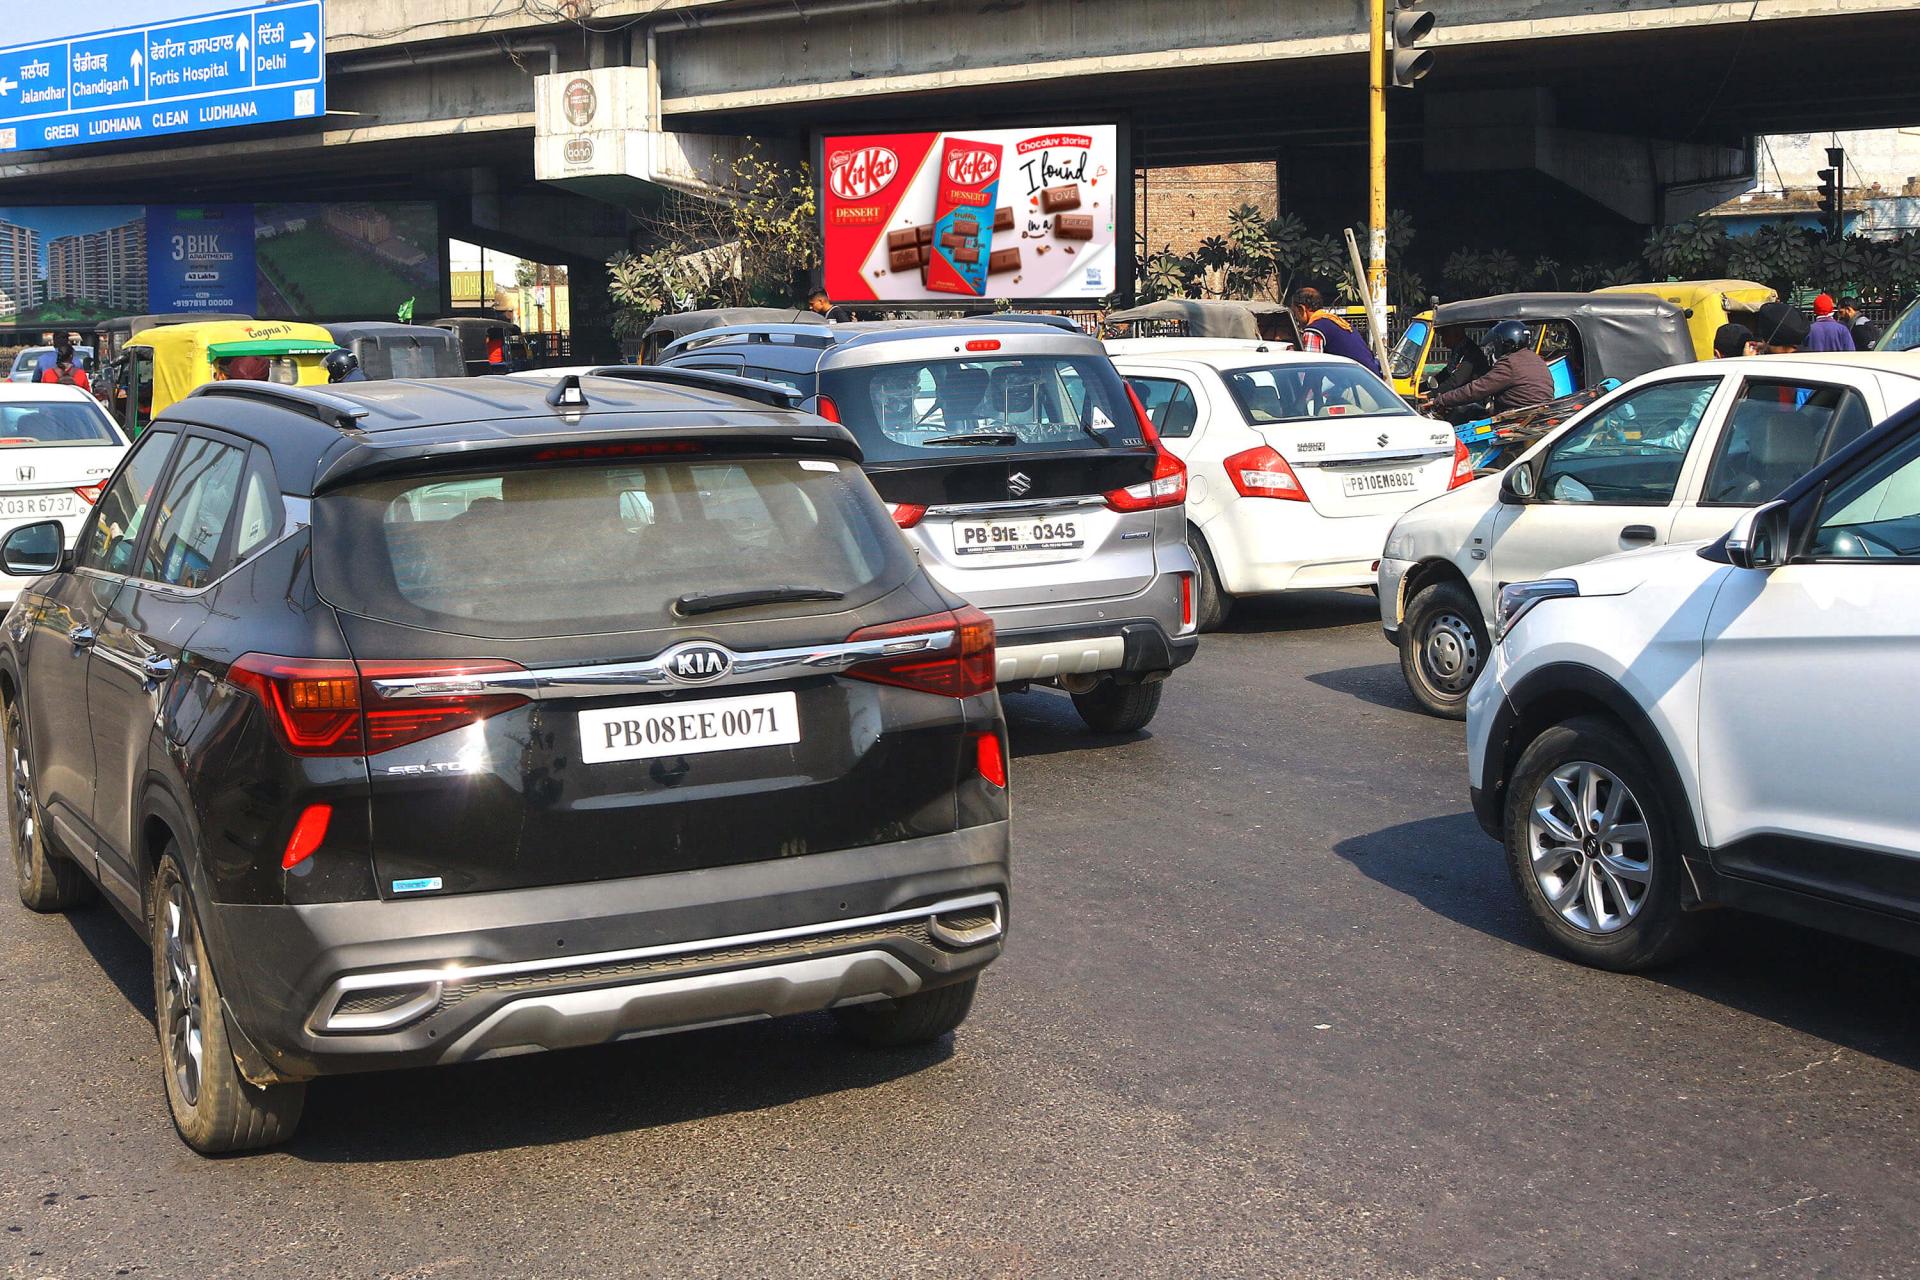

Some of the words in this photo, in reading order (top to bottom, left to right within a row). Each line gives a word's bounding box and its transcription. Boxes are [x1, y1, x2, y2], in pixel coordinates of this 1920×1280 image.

[257, 22, 285, 46] ਦਿੱਲੀ
[188, 34, 235, 56] ਹਸਪਤਾਲ
[20, 59, 50, 80] ਜਲੰਧਰ
[150, 69, 180, 87] Fortis
[183, 61, 229, 83] Hospital
[257, 55, 287, 72] Delhi
[20, 87, 66, 104] Jalandhar
[72, 76, 129, 97] Chandigarh
[44, 123, 79, 140] GREEN
[88, 116, 142, 136] LUDHIANA
[152, 110, 189, 128] CLEAN
[199, 101, 258, 122] LUDHIANA
[1019, 138, 1060, 152] Chocoluv
[1062, 136, 1090, 146] Stories
[841, 149, 892, 196] KitKat
[954, 151, 992, 183] KitKat
[1041, 150, 1088, 187] found
[951, 190, 985, 203] DESSERT
[1050, 191, 1076, 202] LOVE
[836, 207, 880, 217] DESSERT
[1028, 220, 1040, 231] in
[1043, 219, 1052, 230] a
[171, 235, 185, 260] 3
[187, 235, 220, 253] BHK
[464, 274, 495, 296] DHAA
[248, 327, 281, 340] Gogna
[86, 467, 115, 475] CITY
[1032, 522, 1076, 541] 0345
[675, 652, 723, 675] KIA
[387, 761, 481, 776] SELTO
